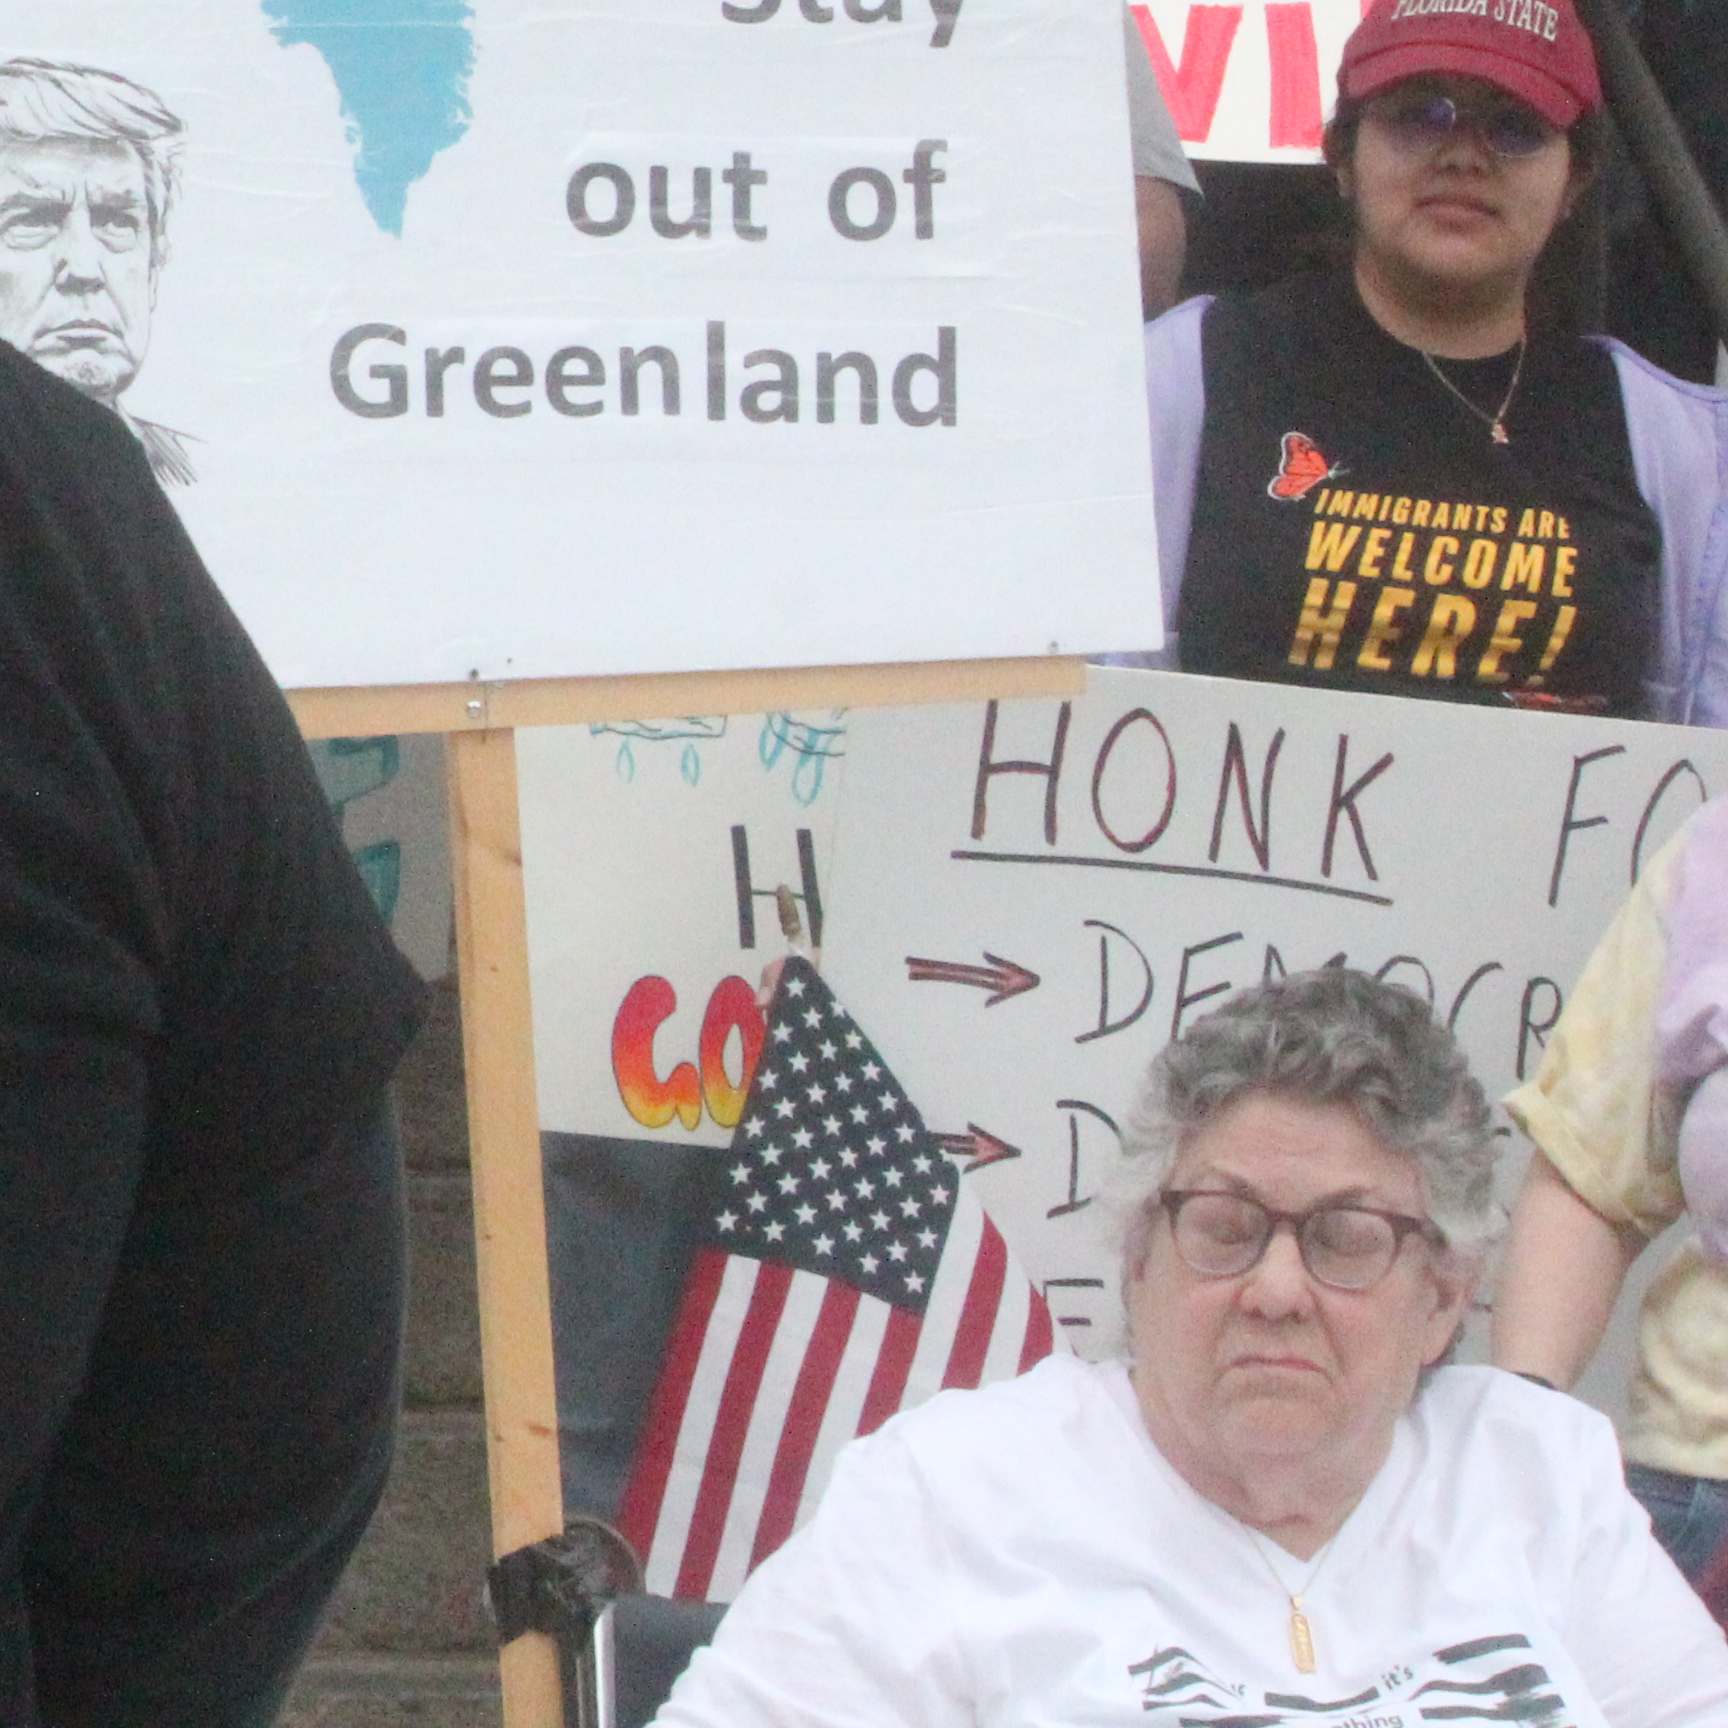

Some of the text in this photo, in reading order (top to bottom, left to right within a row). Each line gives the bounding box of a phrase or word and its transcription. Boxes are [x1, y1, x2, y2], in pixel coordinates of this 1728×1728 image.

[564, 138, 949, 242] out of
[327, 321, 960, 429] Greenland
[1303, 520, 1578, 600] WELCOME
[1315, 487, 1572, 540] IMMIGRANTS ARE
[1286, 576, 1577, 687] HERE!
[971, 696, 1710, 910] HONK FO
